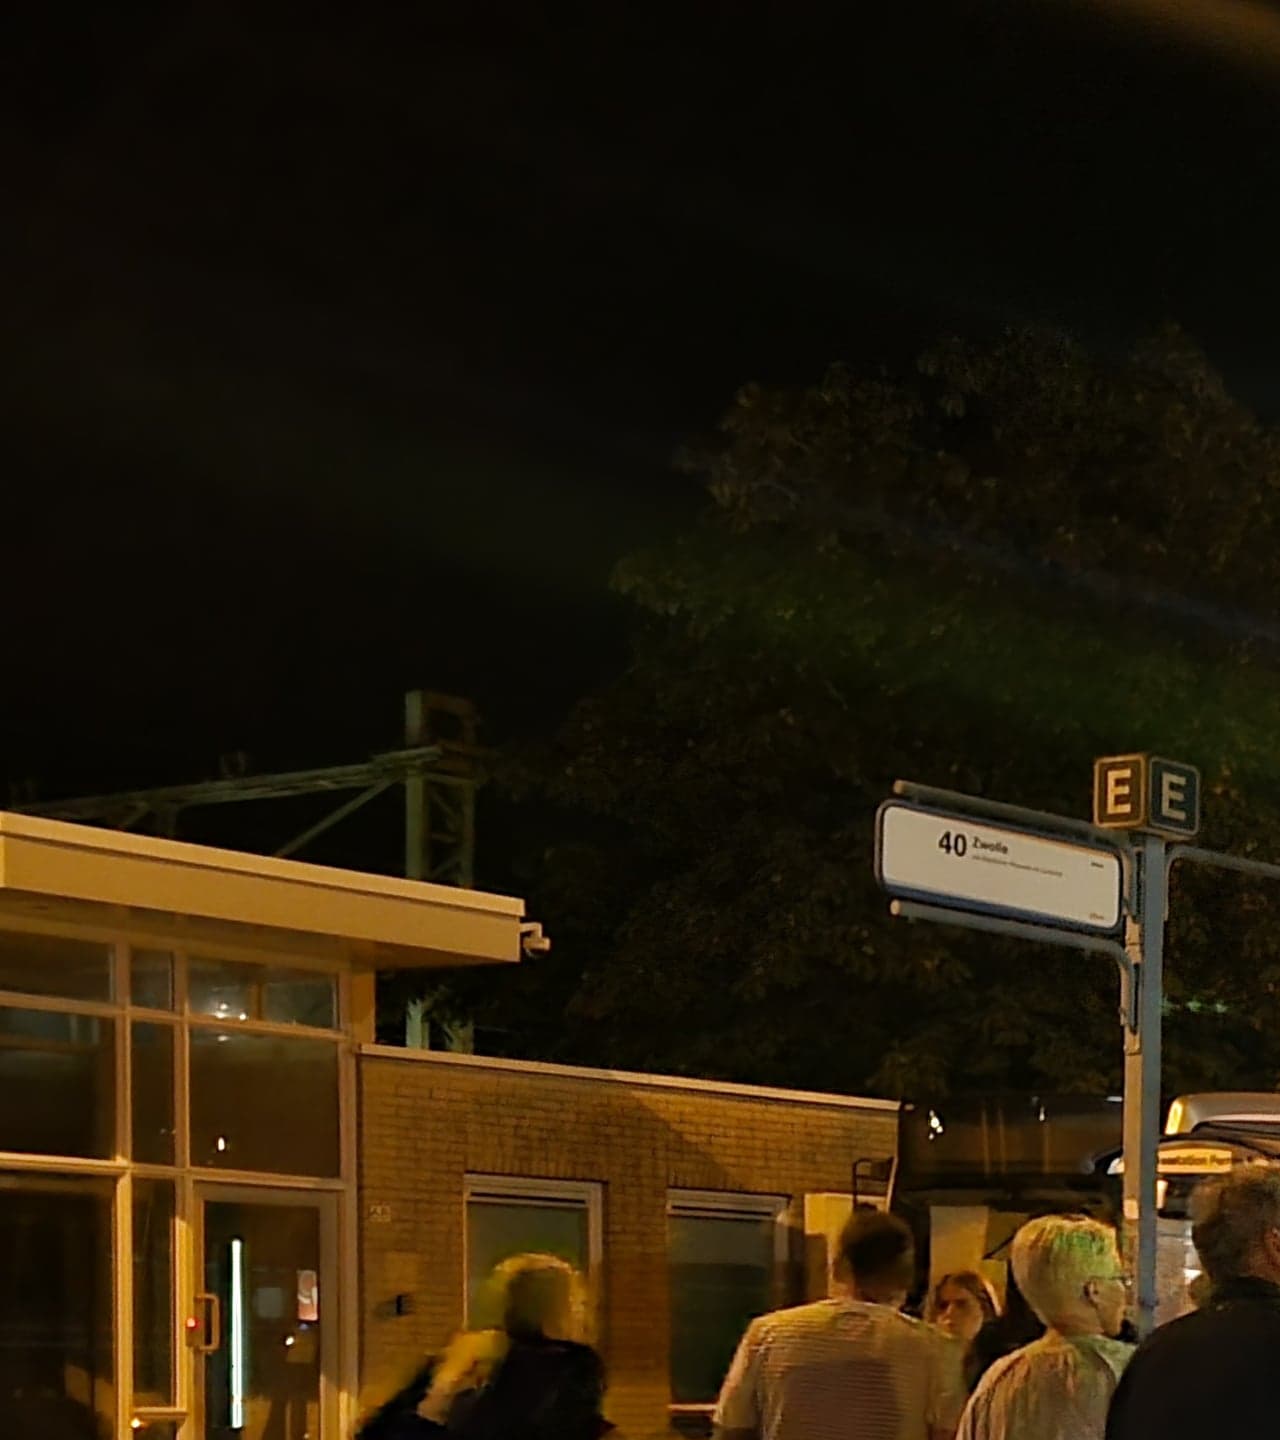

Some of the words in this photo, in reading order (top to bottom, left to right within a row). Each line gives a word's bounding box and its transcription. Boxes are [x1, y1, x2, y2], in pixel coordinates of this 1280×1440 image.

[1106, 768, 1132, 815] E
[1161, 771, 1187, 821] E
[938, 831, 967, 857] 40
